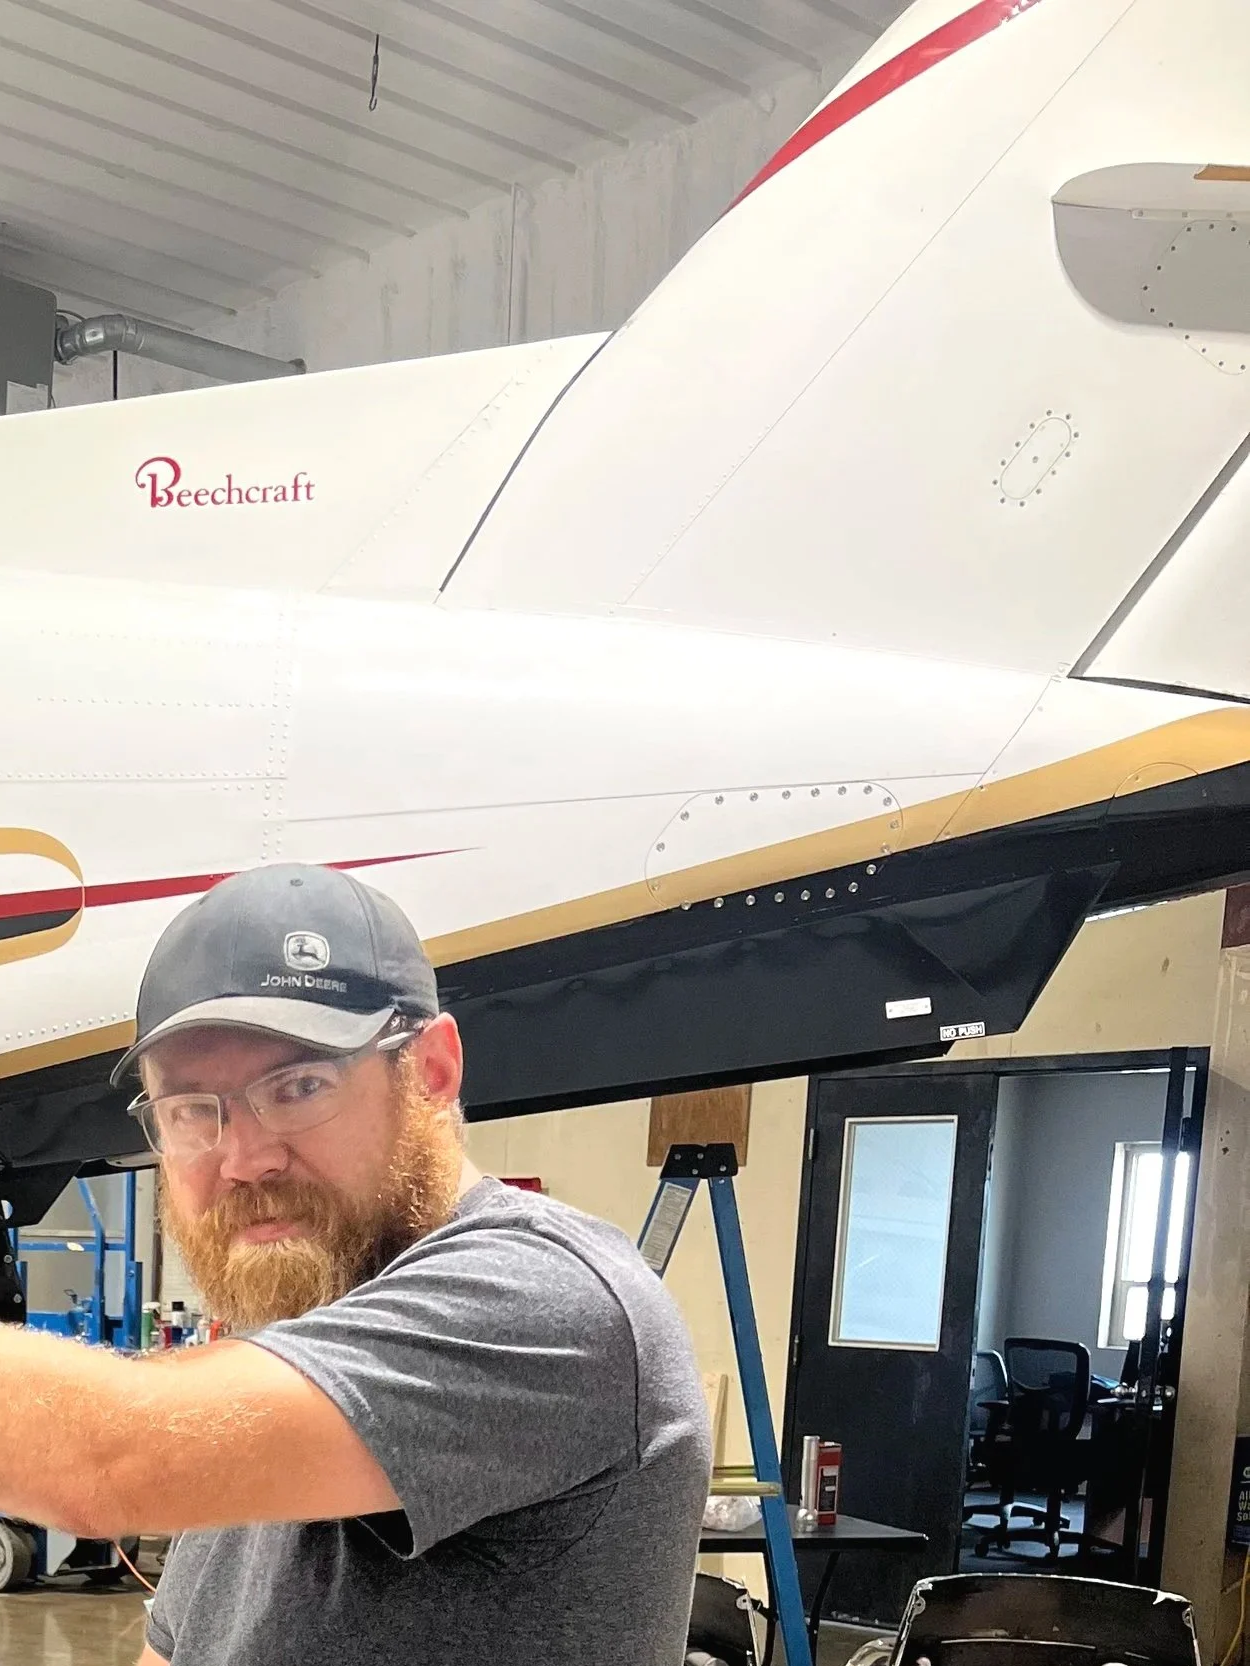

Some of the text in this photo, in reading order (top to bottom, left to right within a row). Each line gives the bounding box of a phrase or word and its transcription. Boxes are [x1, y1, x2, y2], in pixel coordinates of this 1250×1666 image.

[135, 456, 315, 508] Beechcraft
[260, 974, 348, 992] JOHN DEERE
[942, 1024, 983, 1039] NO PUSH
